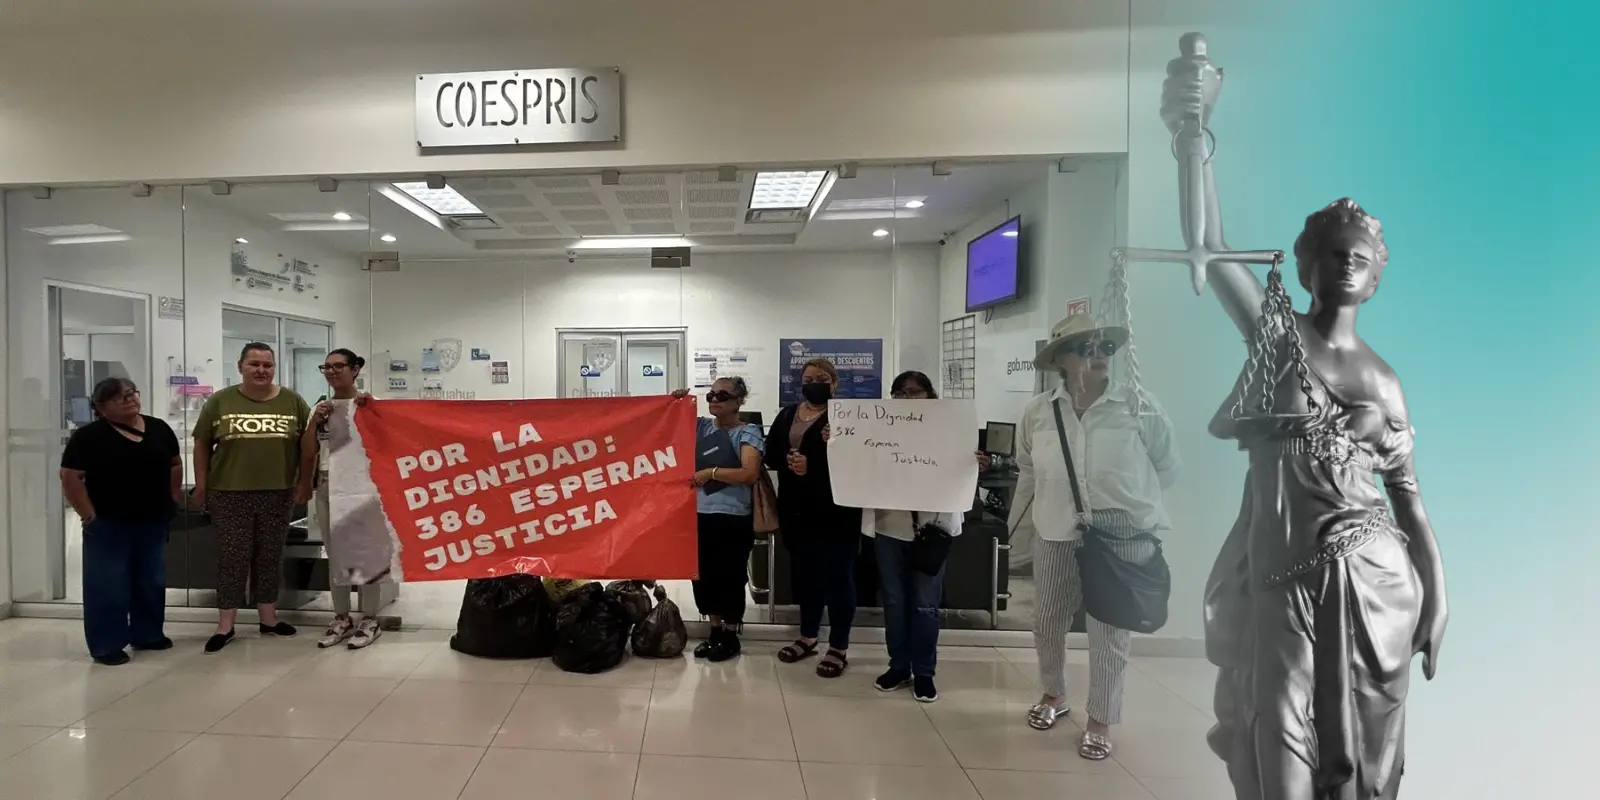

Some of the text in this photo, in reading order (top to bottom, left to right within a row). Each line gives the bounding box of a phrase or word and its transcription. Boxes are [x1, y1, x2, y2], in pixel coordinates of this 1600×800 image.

[436, 75, 599, 128] COESPRIS
[837, 356, 874, 365] DESCUENTOS
[229, 418, 289, 433] KORS
[833, 402, 923, 426] Por la Dignidad
[396, 422, 543, 480] POR LA
[404, 435, 617, 511] DIGNIDAD:
[414, 446, 678, 540] 386 ESPERAN
[423, 499, 618, 571] JUSTICIA
